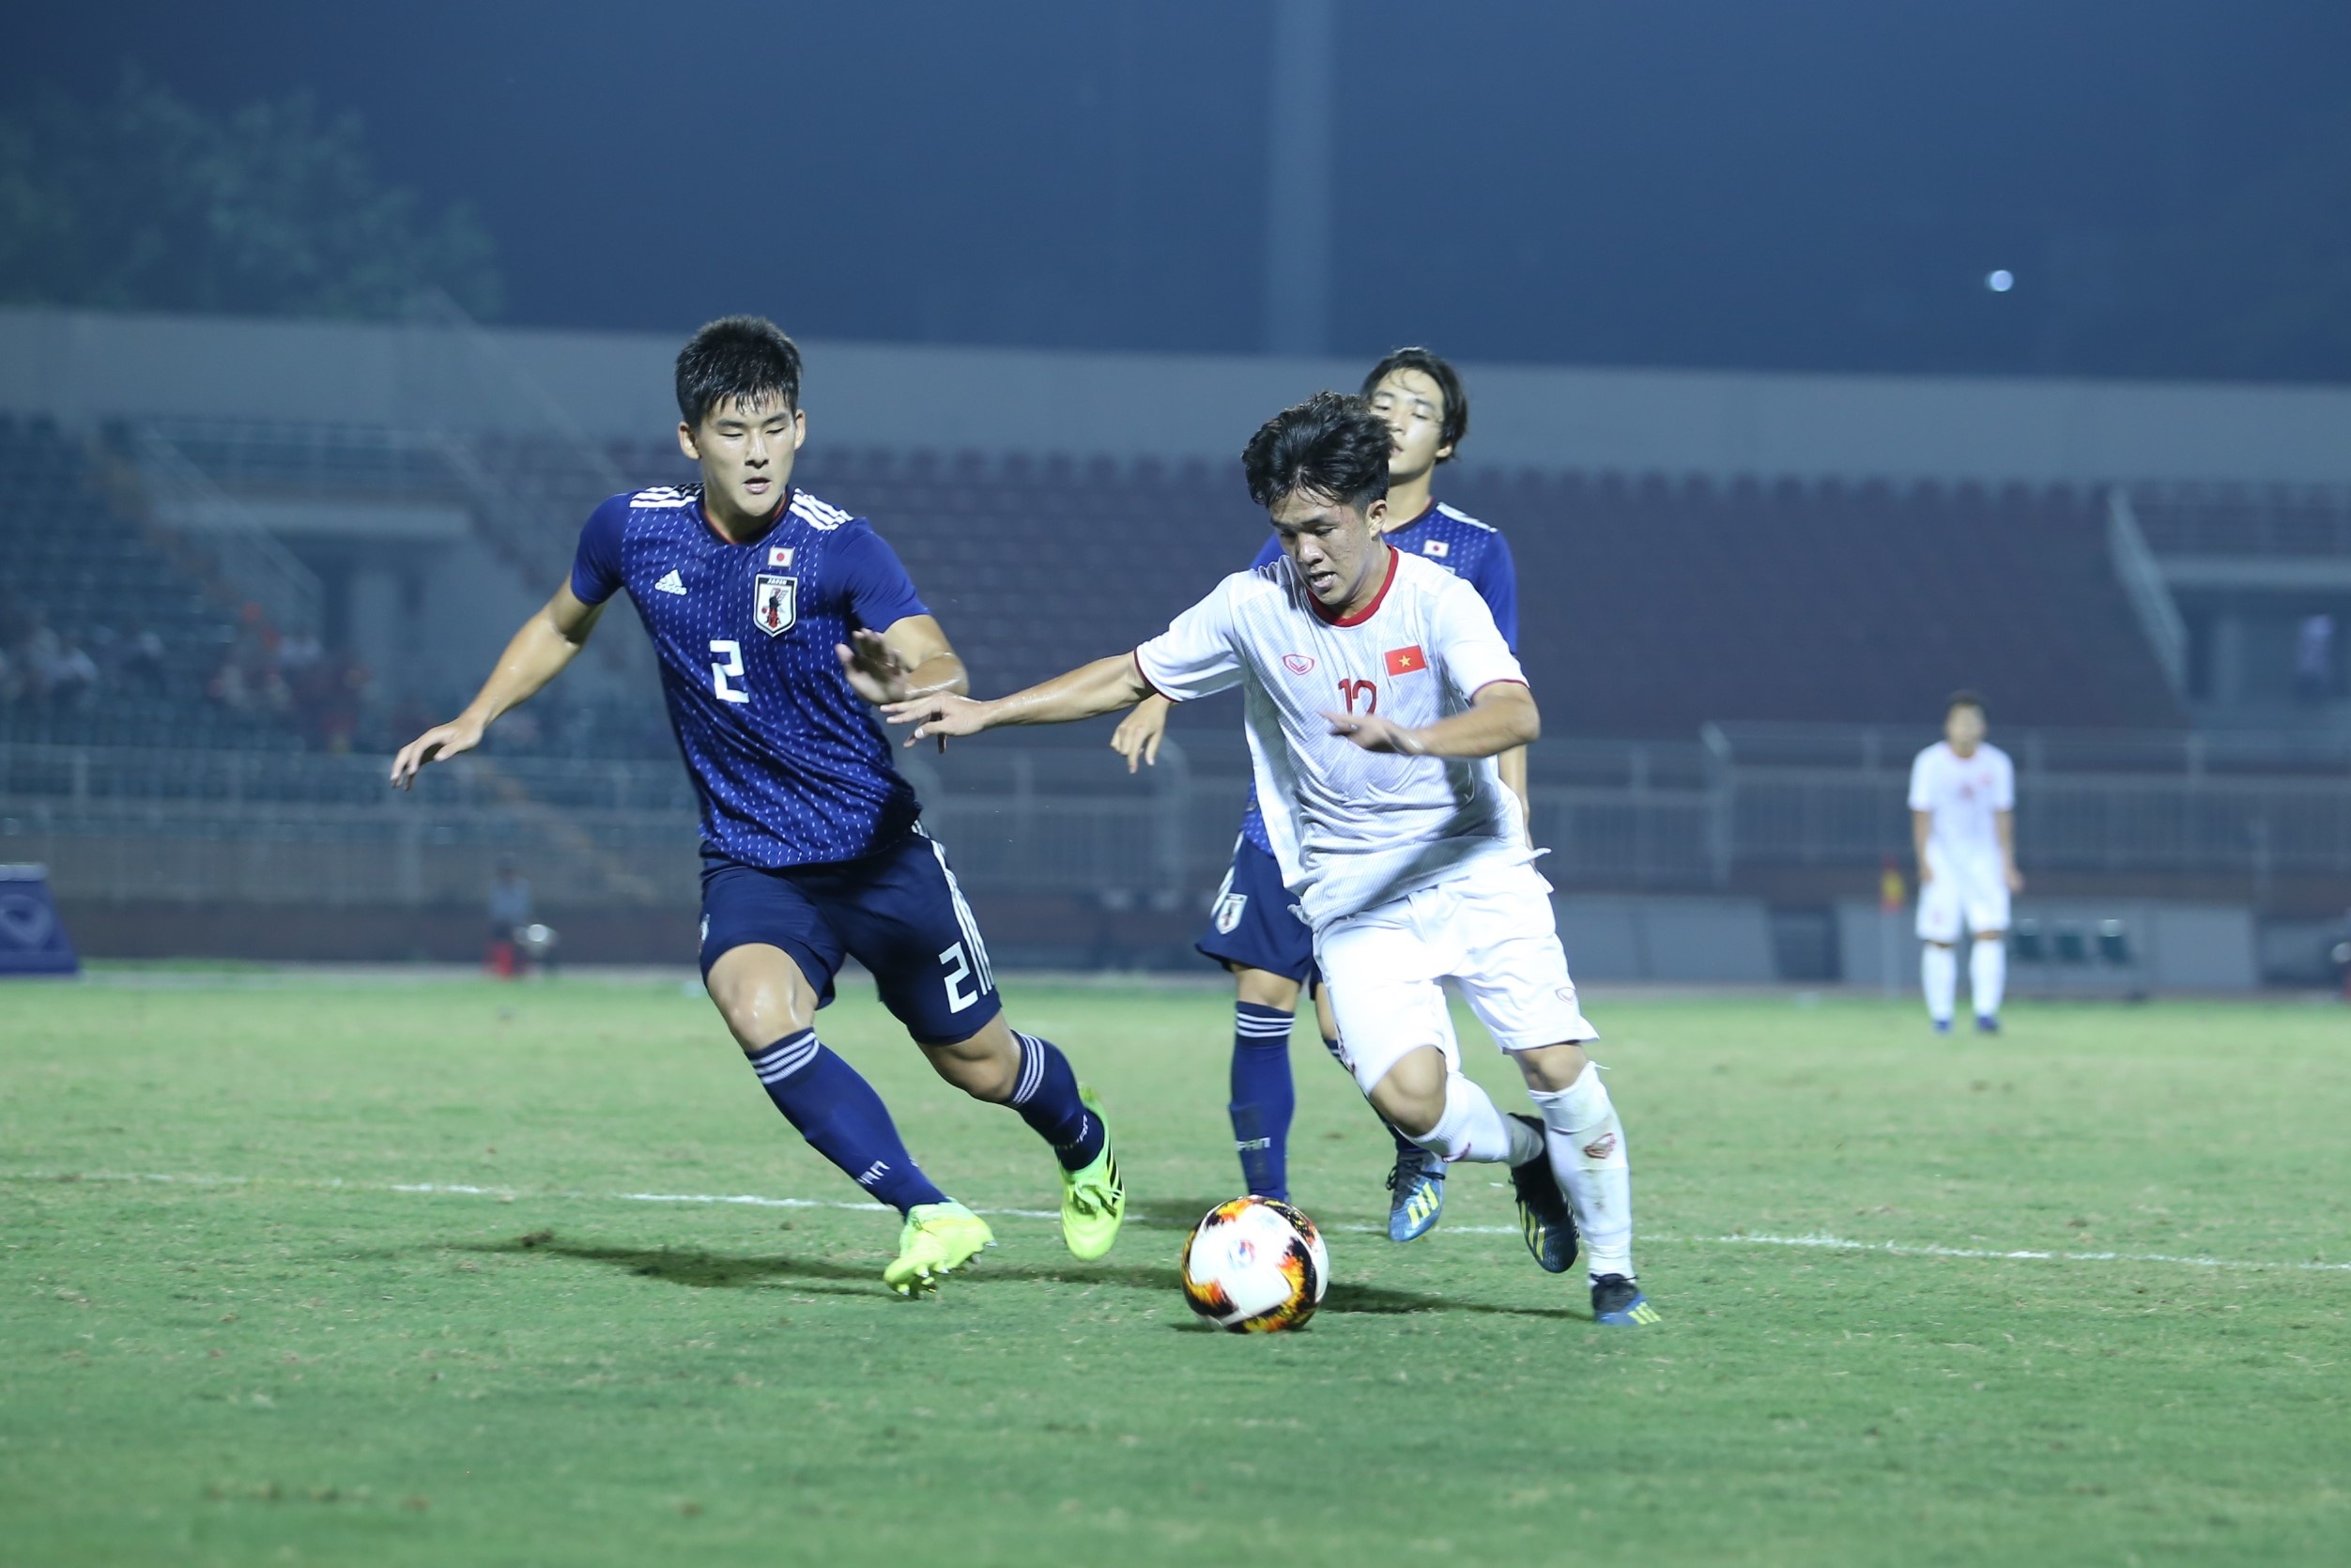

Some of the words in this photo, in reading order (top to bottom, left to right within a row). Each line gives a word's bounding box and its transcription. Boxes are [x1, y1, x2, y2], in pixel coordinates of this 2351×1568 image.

[654, 581, 687, 596] adidas
[709, 640, 750, 703] 2
[939, 941, 978, 1014] 2
